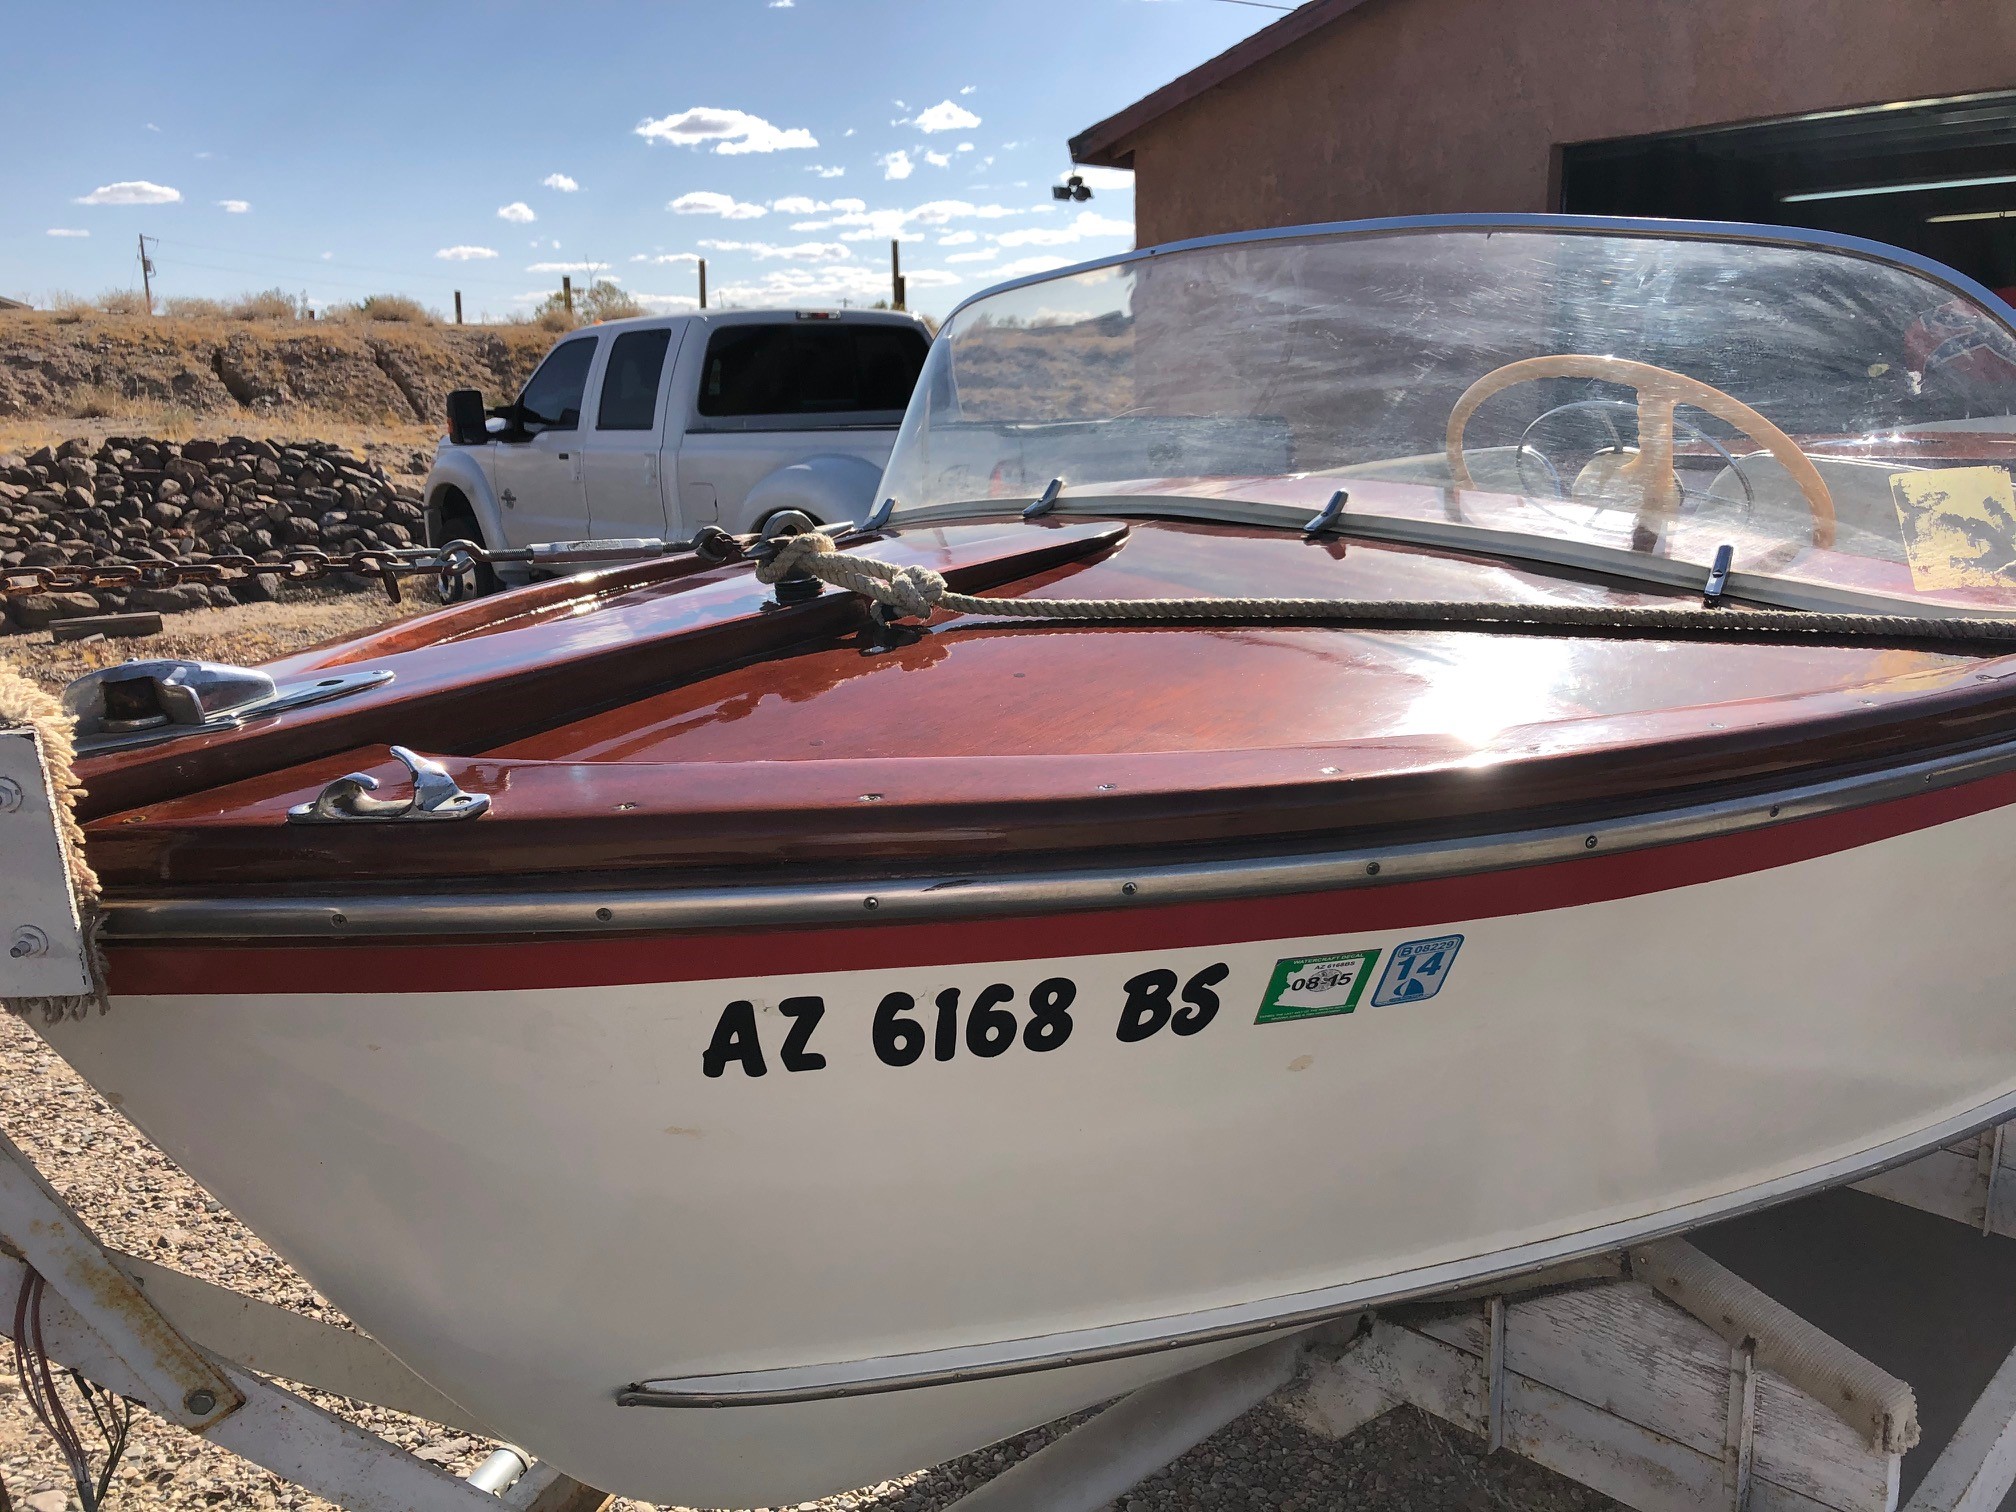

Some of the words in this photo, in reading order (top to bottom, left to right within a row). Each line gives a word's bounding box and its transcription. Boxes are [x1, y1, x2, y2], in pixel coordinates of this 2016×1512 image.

[1400, 947, 1412, 956] B
[1414, 940, 1455, 954] 08229
[1293, 955, 1340, 965] WATERCRAFT
[1326, 961, 1356, 969] 6168BS
[1397, 951, 1446, 981] 14
[1291, 972, 1354, 991] 08-15
[702, 995, 827, 1078] AZ
[871, 977, 1078, 1068] 6168
[1115, 962, 1231, 1043] BS
